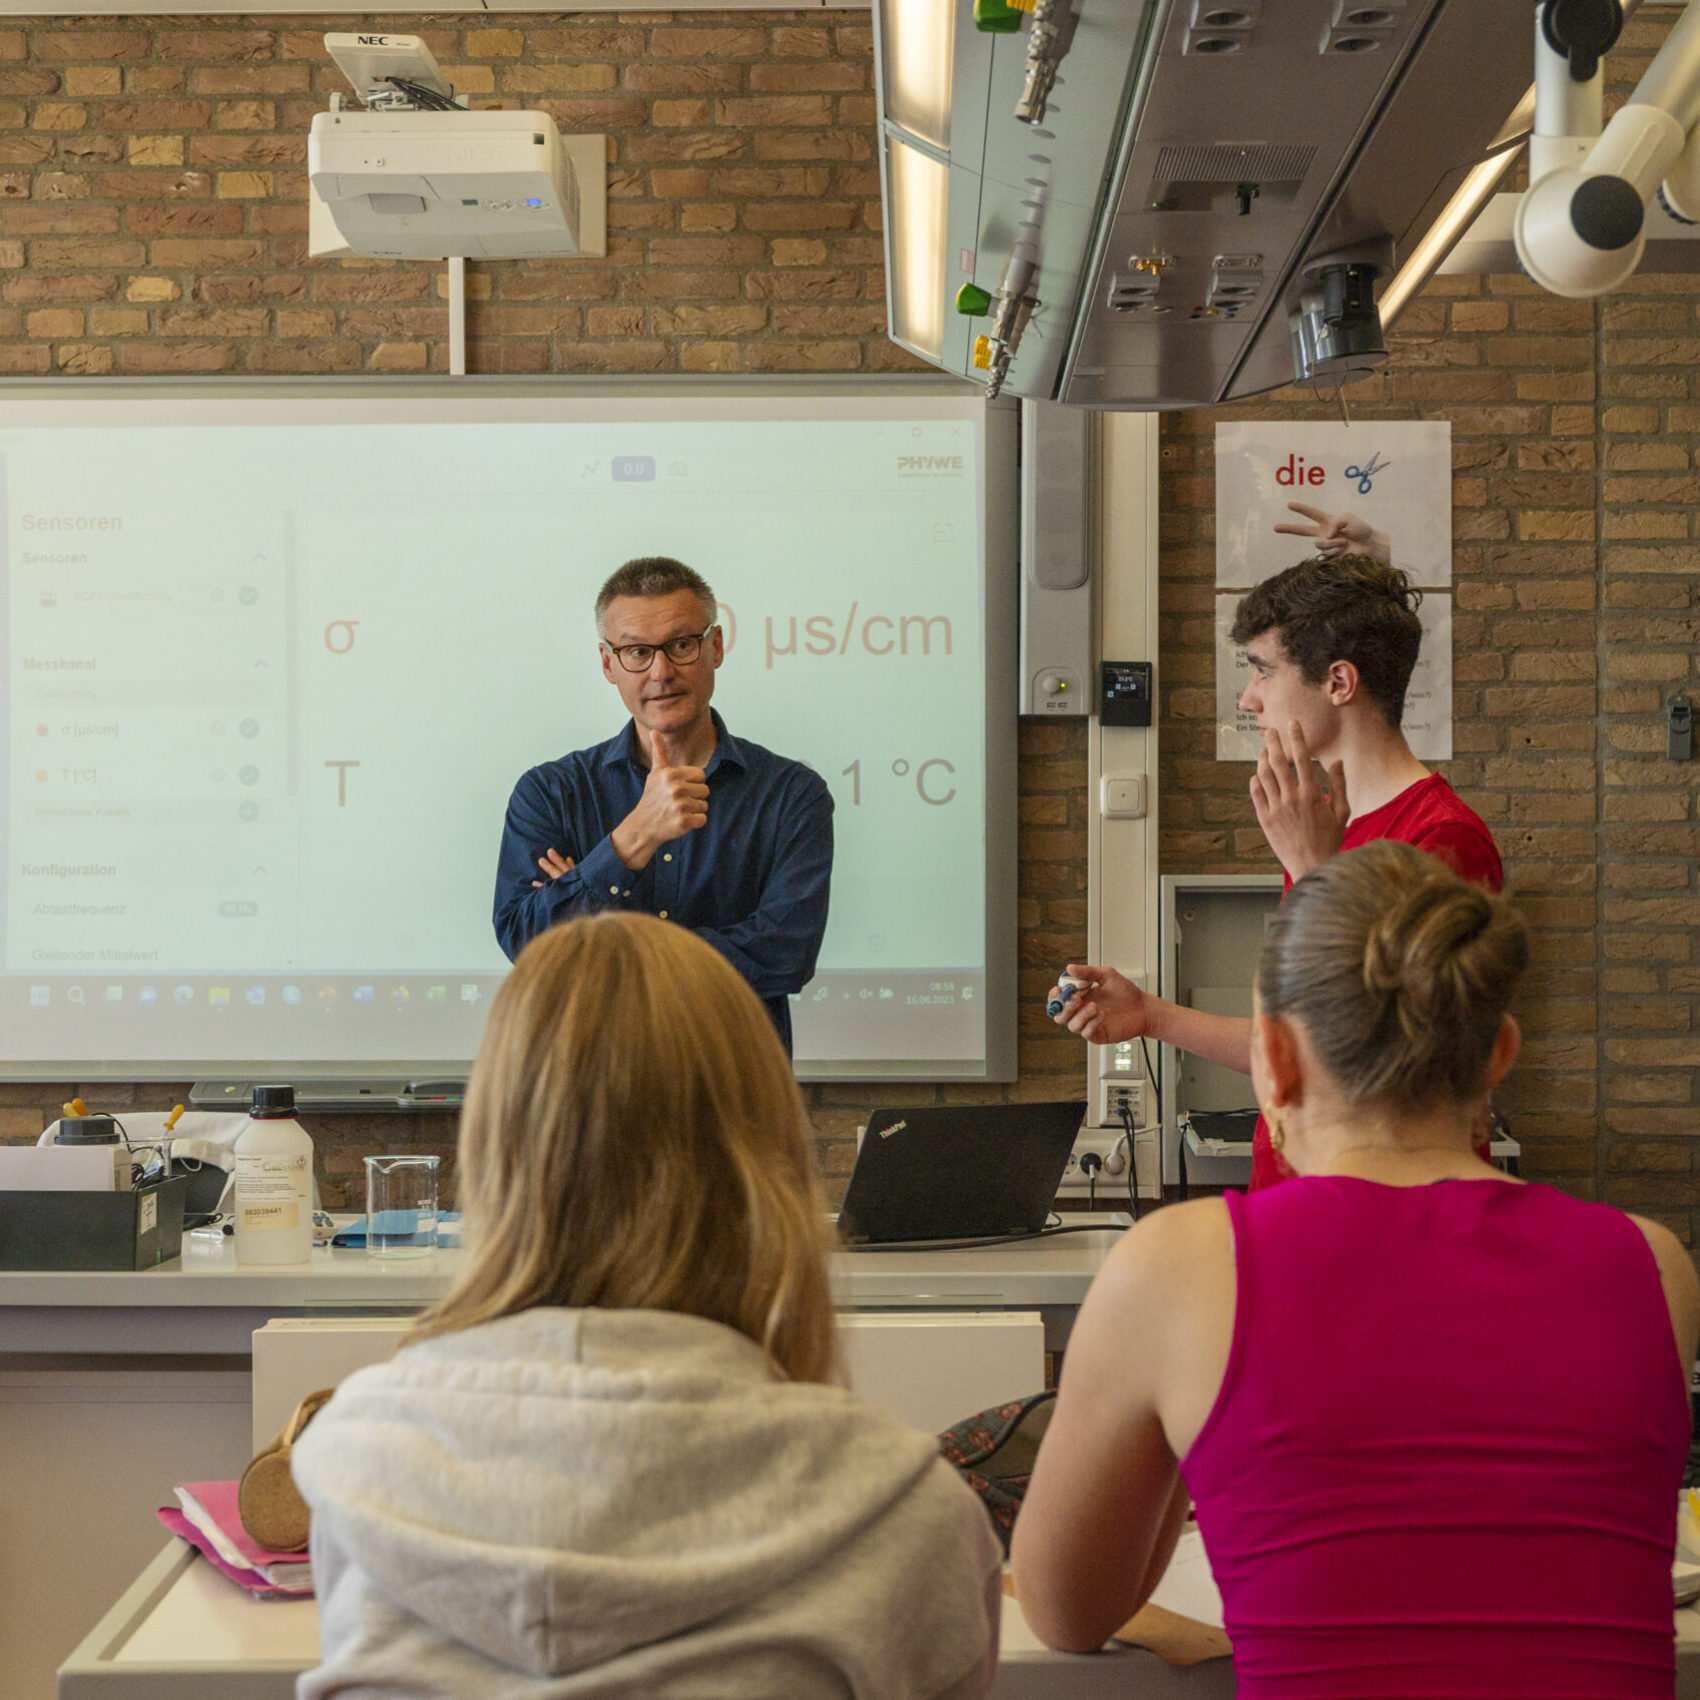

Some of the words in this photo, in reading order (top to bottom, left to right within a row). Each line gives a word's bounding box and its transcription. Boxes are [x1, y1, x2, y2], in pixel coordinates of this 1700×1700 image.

[357, 36, 389, 46] NEC
[896, 455, 963, 469] PHYWE
[1275, 453, 1326, 486] die
[22, 514, 123, 532] Sensoren
[22, 552, 88, 565] Sensoren
[23, 656, 97, 671] Messkanal
[324, 760, 360, 807] T
[891, 758, 957, 807] °C
[22, 863, 117, 879] Konfiguration
[33, 903, 127, 917] Abtastfrequenz
